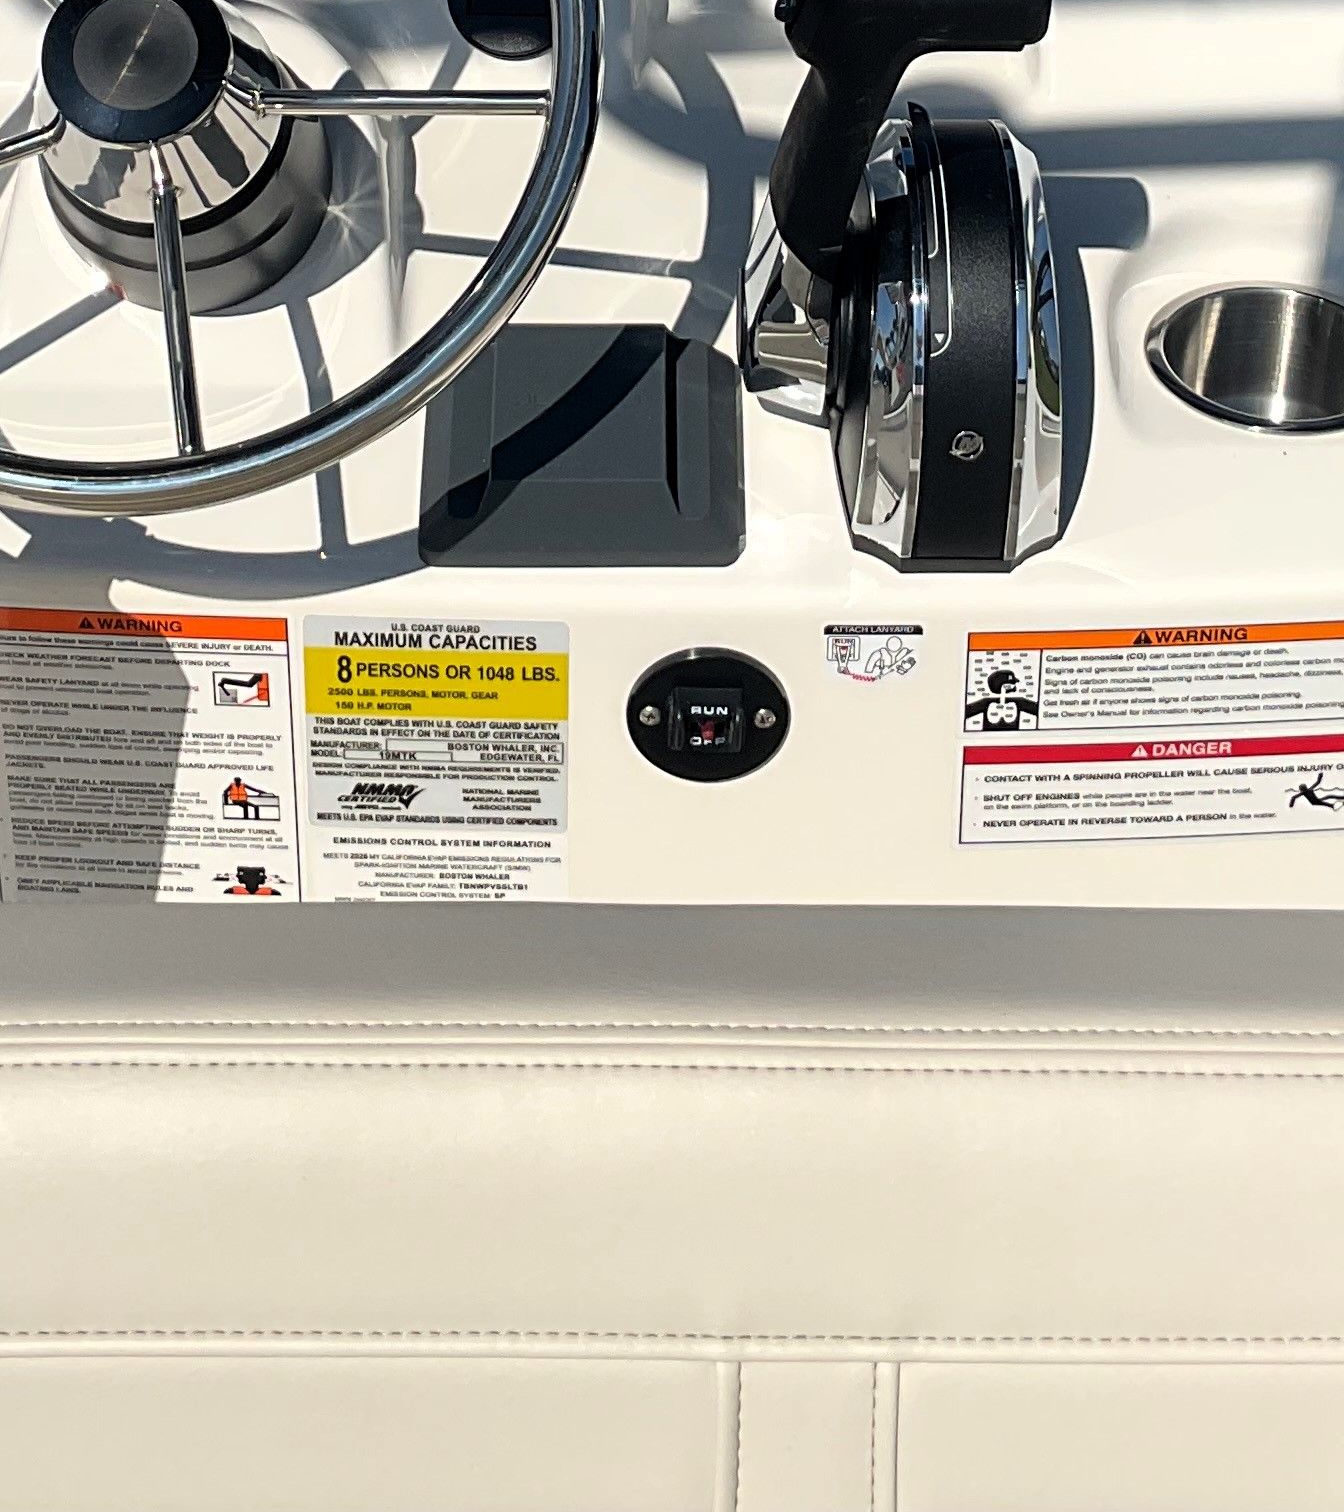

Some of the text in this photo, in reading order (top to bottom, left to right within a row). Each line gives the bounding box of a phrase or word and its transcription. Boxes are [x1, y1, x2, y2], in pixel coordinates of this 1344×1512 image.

[97, 618, 182, 633] WARNING
[391, 623, 480, 633] U.S. COAST GUARD
[832, 626, 914, 634] ATTACH LANYARD
[334, 631, 536, 650] MAXIMUM CAPACITIES
[1155, 628, 1248, 644] WARNING
[337, 655, 352, 683] 8
[356, 662, 560, 681] PERSONS OR 1048 LBS.
[327, 687, 353, 696] 2500
[470, 691, 498, 699] GEAR
[335, 701, 353, 709] 150
[376, 702, 411, 710] MOTOR
[690, 705, 729, 715] RUN
[315, 716, 334, 725] THIS
[336, 717, 360, 725] BOAT
[363, 718, 409, 727] COMPLIES
[411, 719, 434, 727] WITH
[455, 720, 486, 728] COAST
[488, 721, 521, 729] GUARD
[523, 722, 558, 730] SAFETY
[313, 726, 367, 735] STANDARDS
[380, 728, 415, 736] EFFECT
[415, 729, 430, 737] ON
[433, 729, 450, 737] THE
[452, 730, 476, 738] DATE
[492, 731, 559, 740] CERTIFICATION
[447, 742, 489, 752] BOSTON
[689, 736, 726, 746] OFF
[1152, 741, 1232, 757] DANGER
[984, 774, 1032, 782] CONTACT
[1073, 772, 1121, 780] SPINNING
[1124, 770, 1184, 778] PROPELLER
[1213, 767, 1247, 775] CAUSE
[1250, 765, 1294, 774] SERIOUS
[1297, 764, 1333, 772] INJURY
[337, 795, 397, 803] CERTIFIED
[1012, 793, 1032, 801] OFF
[1035, 792, 1080, 800] ENGINES
[1019, 818, 1065, 826] OPERATE
[1081, 817, 1126, 825] REVERSE
[1130, 815, 1173, 823] TOWARD
[1185, 813, 1226, 821] PERSON
[390, 838, 437, 846] CONTROL
